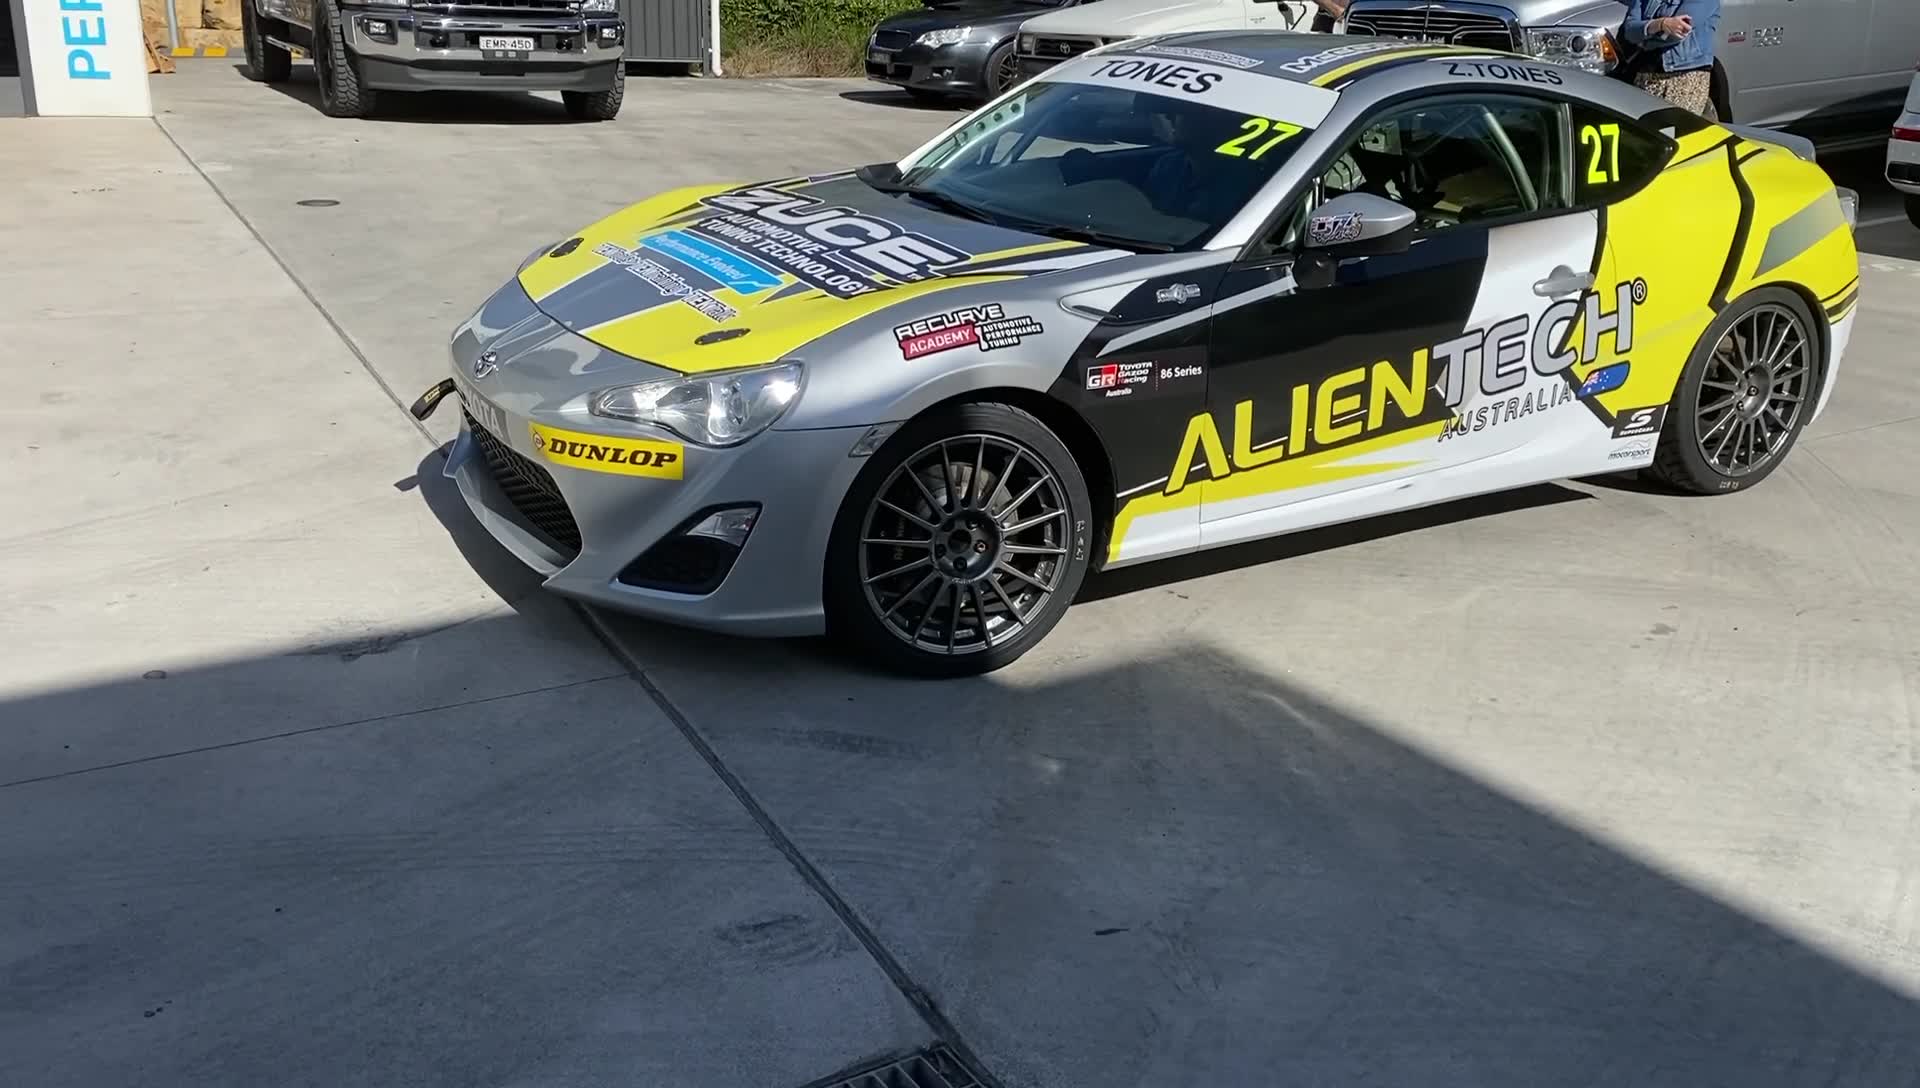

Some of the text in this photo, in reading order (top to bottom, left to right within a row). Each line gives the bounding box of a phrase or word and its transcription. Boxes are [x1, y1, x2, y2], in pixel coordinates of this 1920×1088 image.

[1091, 60, 1223, 94] TONES
[1441, 62, 1563, 85] Z.TONES
[1215, 118, 1303, 160] 27
[1581, 123, 1621, 184] 27
[710, 188, 958, 275] ZUCE
[722, 213, 828, 256] AUTOMOTIVE
[700, 218, 877, 296] TUNING TECHNOLOGY
[895, 305, 1003, 340] RECURVE
[983, 317, 1032, 333] AUTOMOTIVE
[986, 325, 1042, 341] PERFORMANCE
[909, 329, 970, 354] ACADEMY
[989, 337, 1019, 348] TUNING
[1117, 369, 1149, 378] GAZOO
[1118, 361, 1153, 371] TOYOTA
[1160, 364, 1203, 379] 86 Series
[1088, 374, 1116, 387] GR
[1437, 381, 1572, 442] AUSTRALIA
[548, 437, 677, 468] DUNLOP
